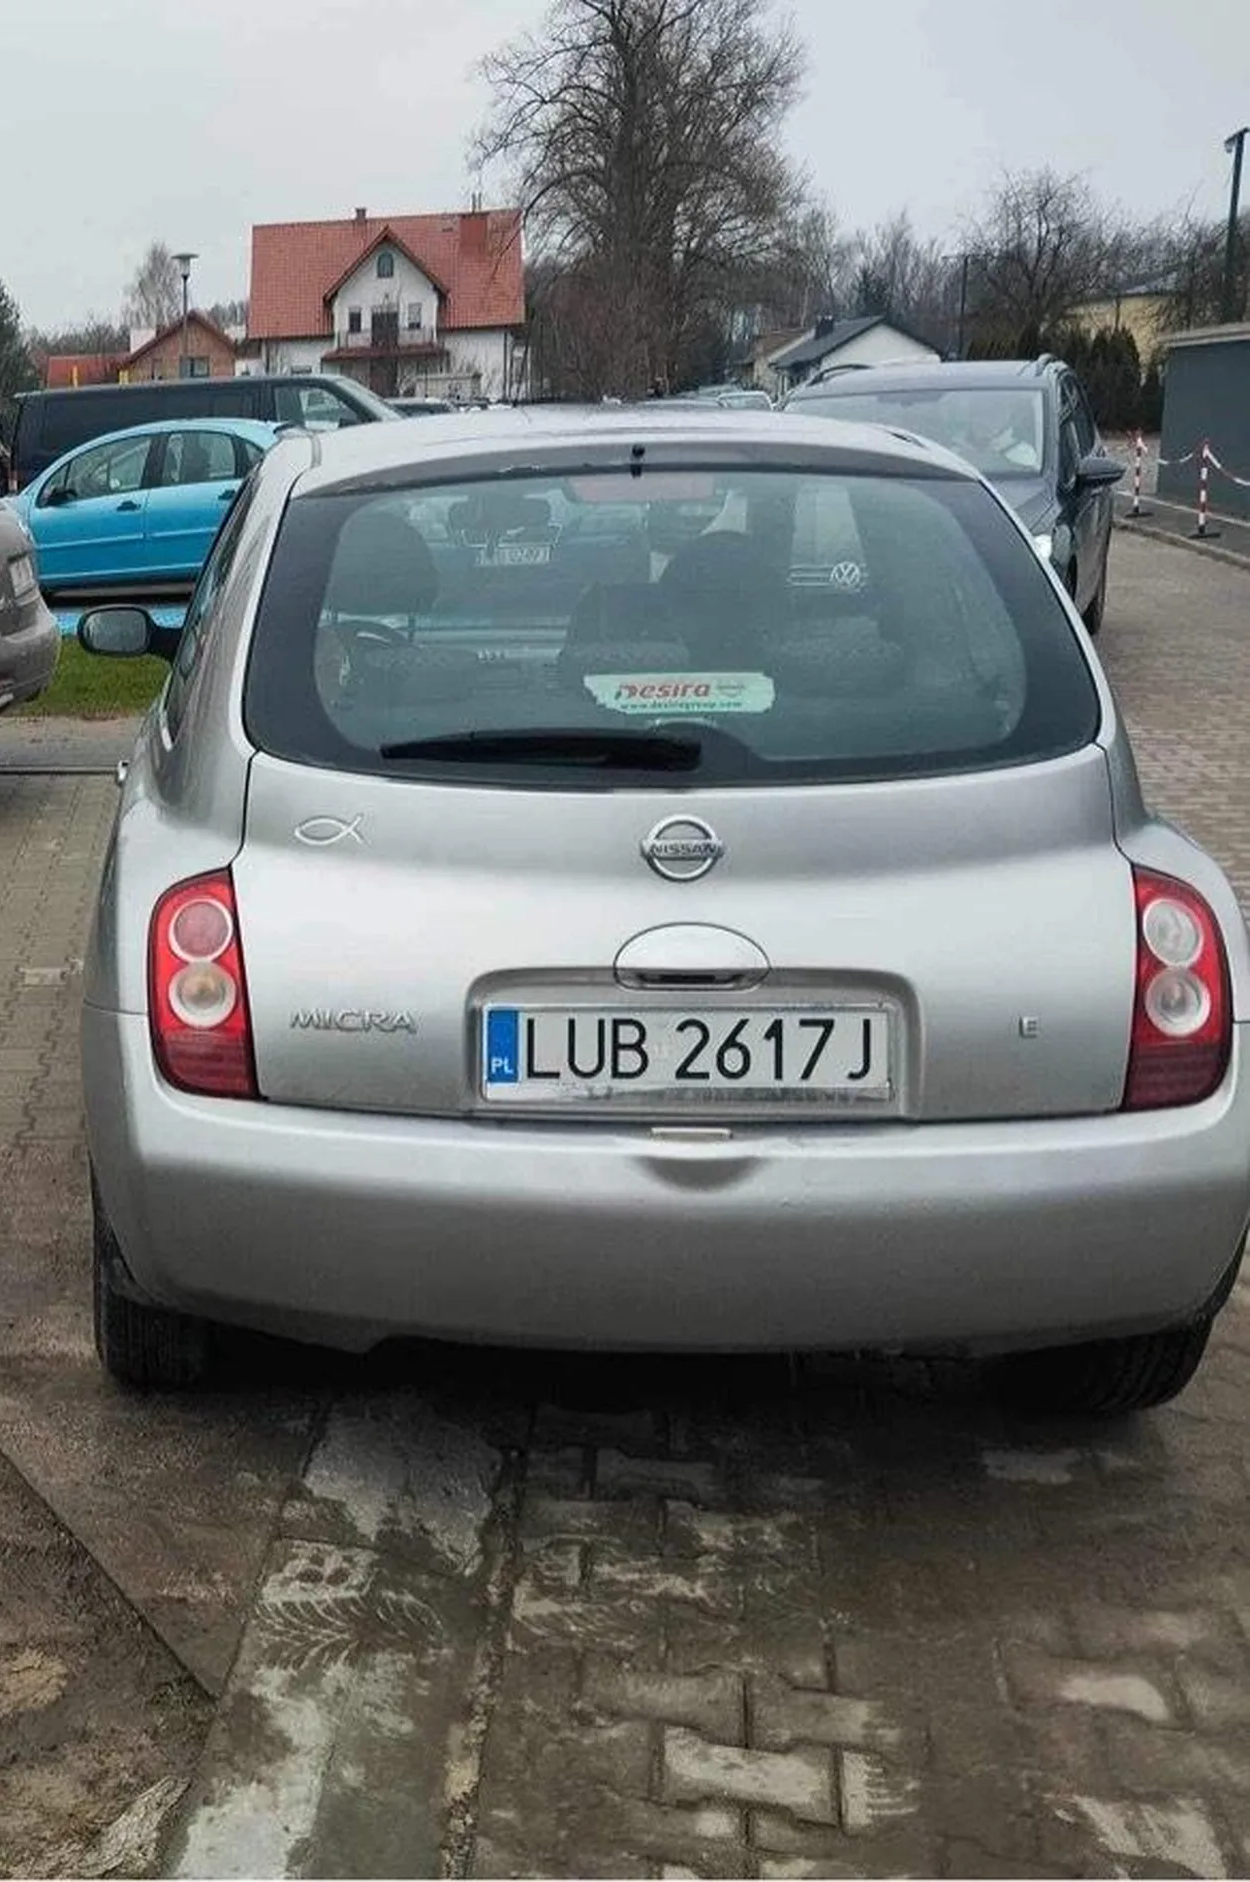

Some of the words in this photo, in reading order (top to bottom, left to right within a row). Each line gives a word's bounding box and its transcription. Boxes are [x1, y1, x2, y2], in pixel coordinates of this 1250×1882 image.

[650, 842, 717, 855] NISSAN
[289, 1008, 418, 1034] MICRA
[526, 1018, 649, 1079] LUB
[675, 1018, 871, 1080] 2617J
[491, 1058, 513, 1075] PL
